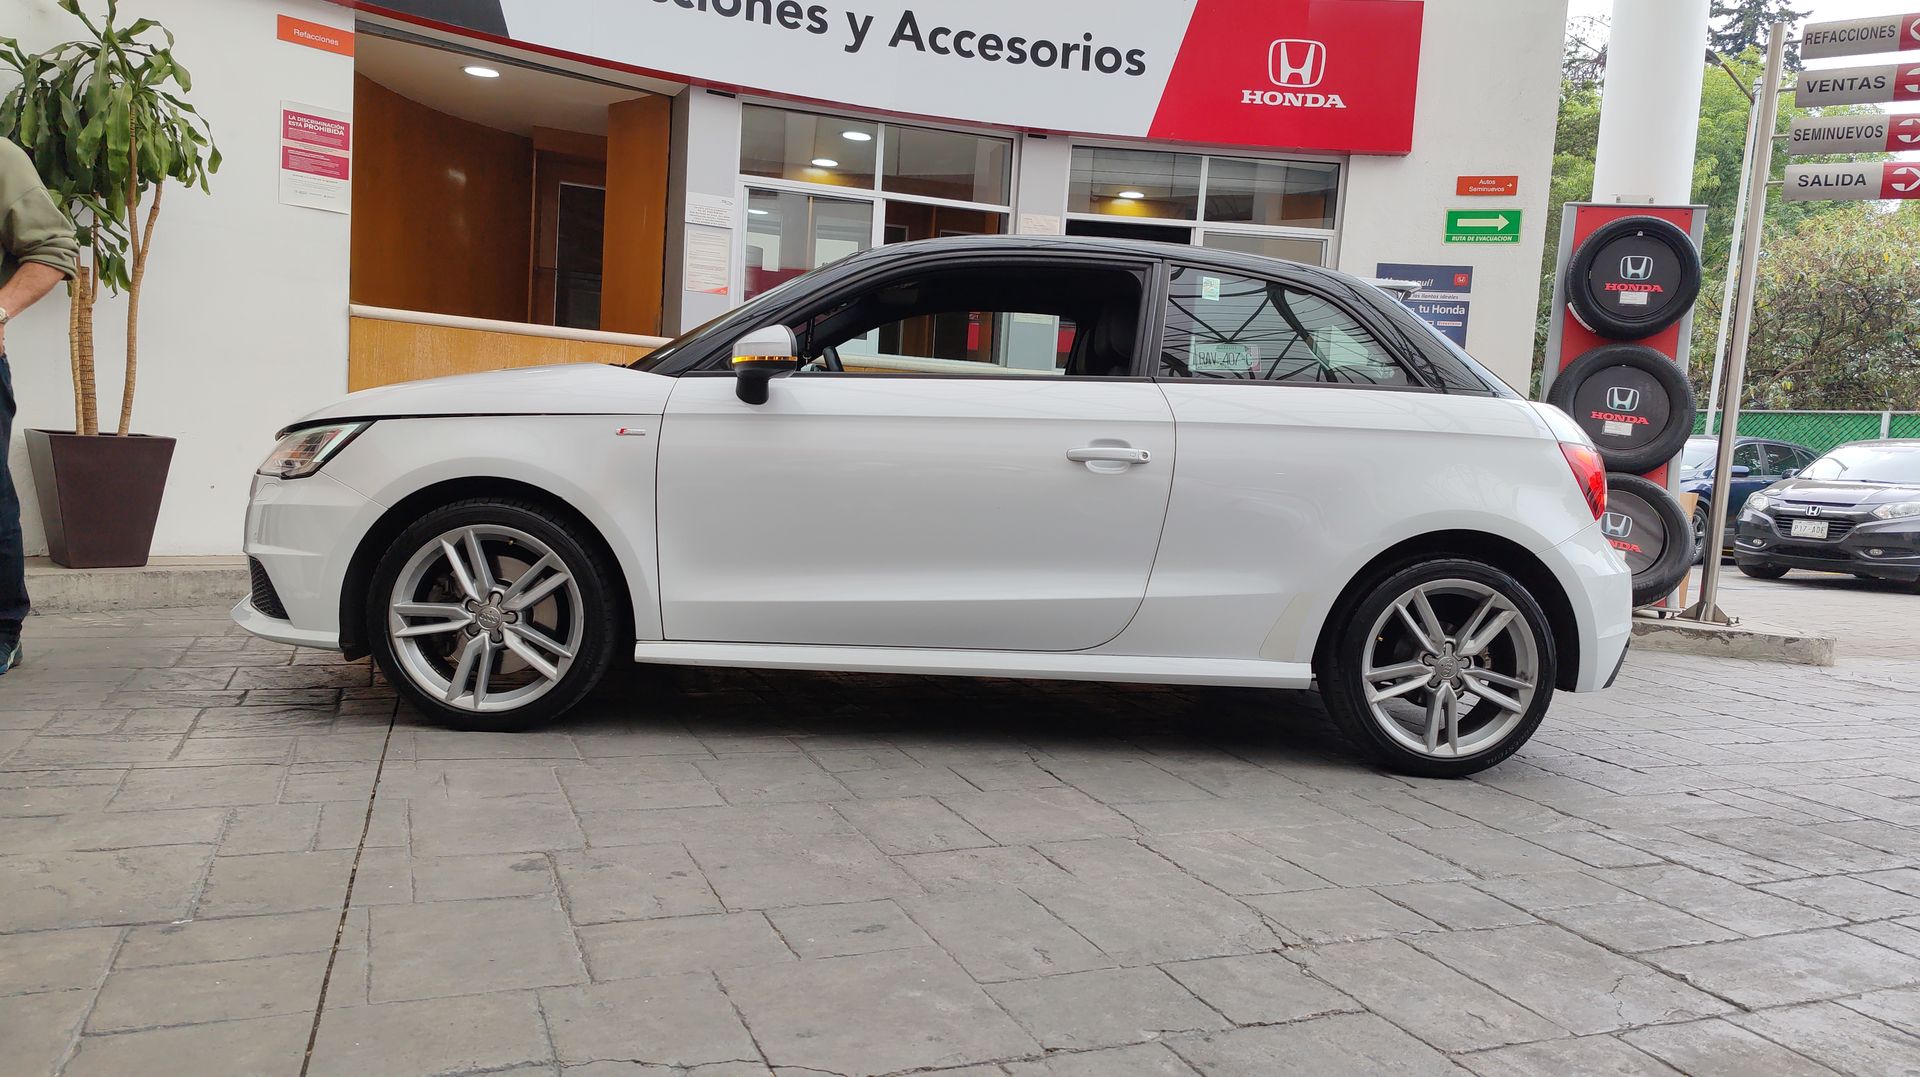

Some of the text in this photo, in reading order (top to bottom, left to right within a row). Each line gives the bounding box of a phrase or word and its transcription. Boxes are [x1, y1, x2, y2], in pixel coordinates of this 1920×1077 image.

[293, 28, 339, 46] Refacciones
[1805, 25, 1896, 45] REFACCIONES
[844, 11, 874, 53] y
[888, 10, 1146, 76] Accesorios
[1806, 75, 1886, 93] VENTAS
[1241, 89, 1347, 108] HONDA
[303, 123, 345, 136] PROHIBIDA
[1794, 125, 1884, 141] SEMINUEVOS
[1798, 173, 1867, 187] SALIDA
[1604, 283, 1664, 292] HONDA
[1419, 305, 1430, 313] tu
[1431, 305, 1466, 315] Honda
[1590, 411, 1649, 425] HONDA
[1607, 538, 1643, 553] NDA
